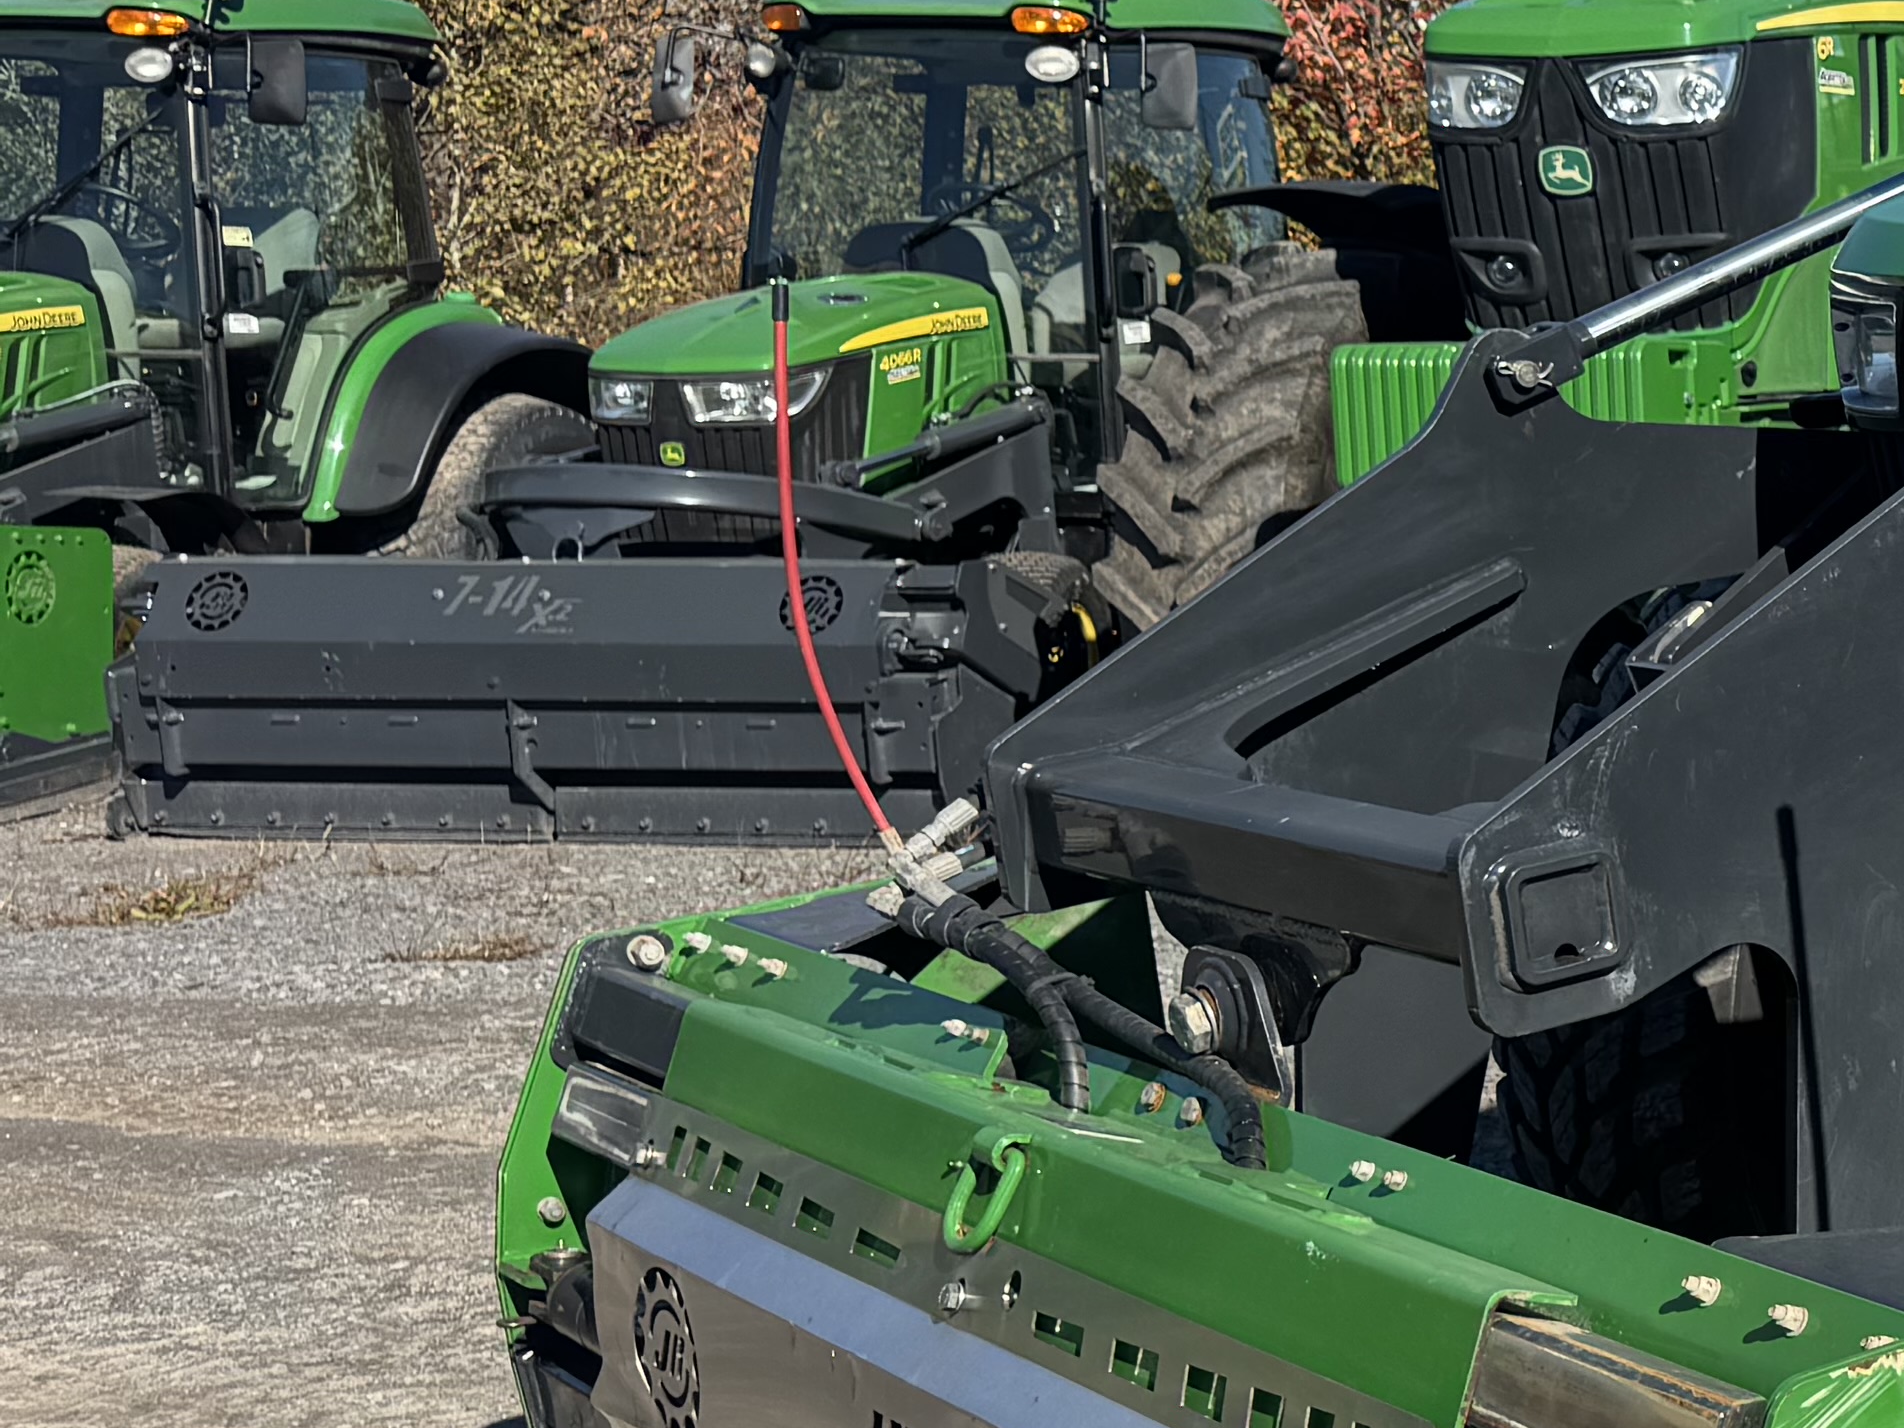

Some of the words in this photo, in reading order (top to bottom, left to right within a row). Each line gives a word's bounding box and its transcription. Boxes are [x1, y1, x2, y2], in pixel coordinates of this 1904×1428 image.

[11, 315, 42, 330] JOHN
[43, 312, 77, 327] DEERE
[930, 319, 954, 334] JOHN
[954, 314, 982, 330] DEERE
[654, 1329, 685, 1381] JR
